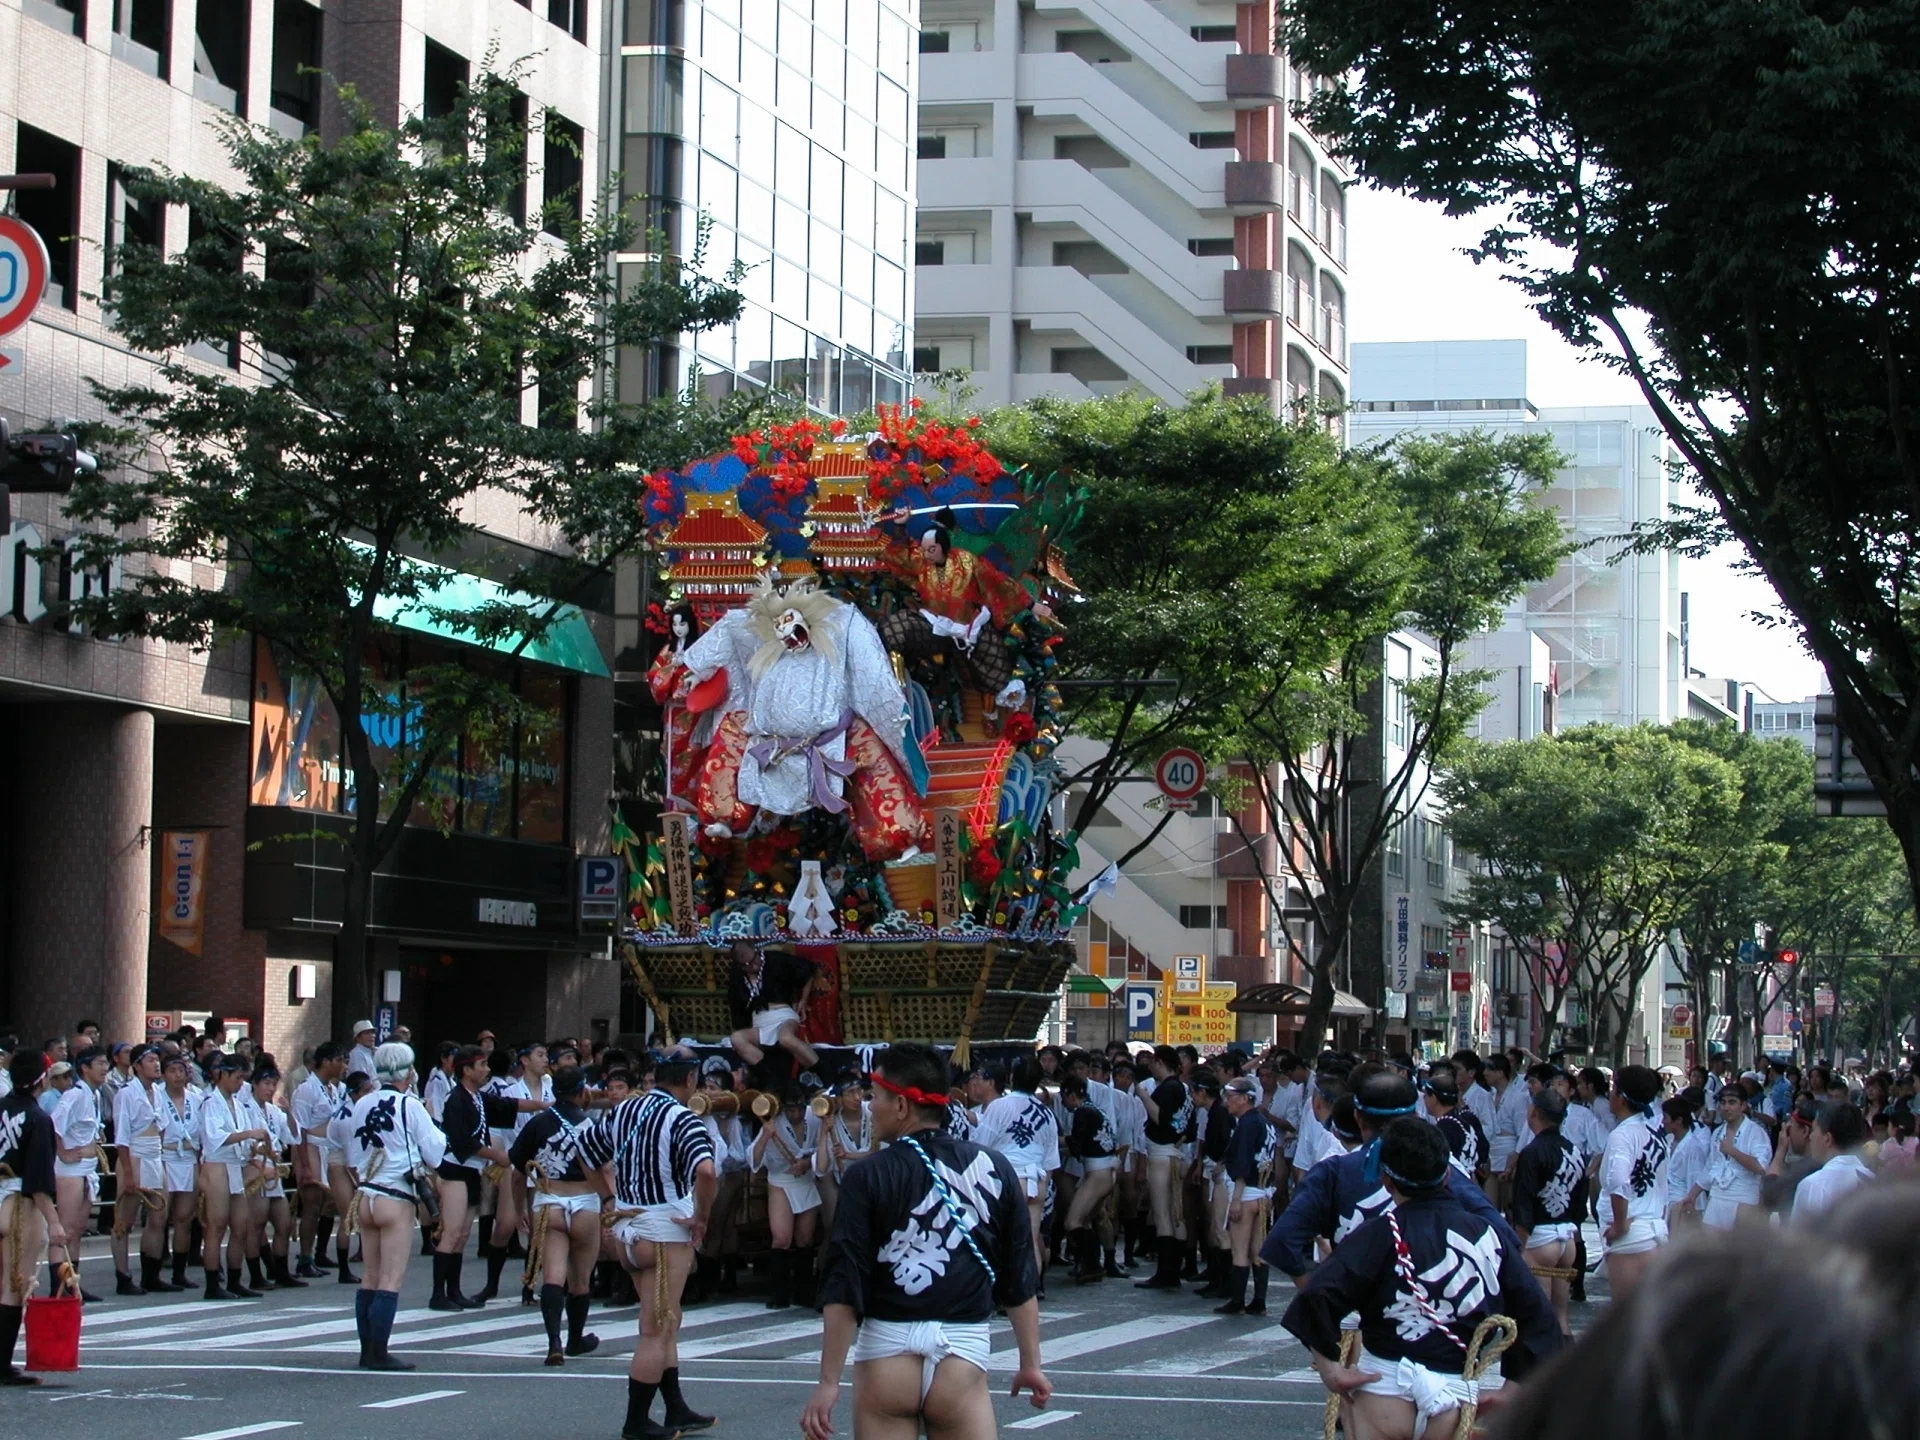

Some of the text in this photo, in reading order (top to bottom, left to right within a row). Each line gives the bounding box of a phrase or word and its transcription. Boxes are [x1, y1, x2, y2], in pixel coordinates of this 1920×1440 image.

[322, 760, 340, 783] I'm
[499, 752, 515, 773] I'm
[1168, 762, 1194, 785] 40
[175, 863, 191, 919] Gion
[586, 860, 616, 895] P
[479, 897, 537, 927] PARKING
[1397, 896, 1409, 990] 竹田歯科クリニック
[1181, 959, 1196, 971] P
[1129, 992, 1154, 1028] P
